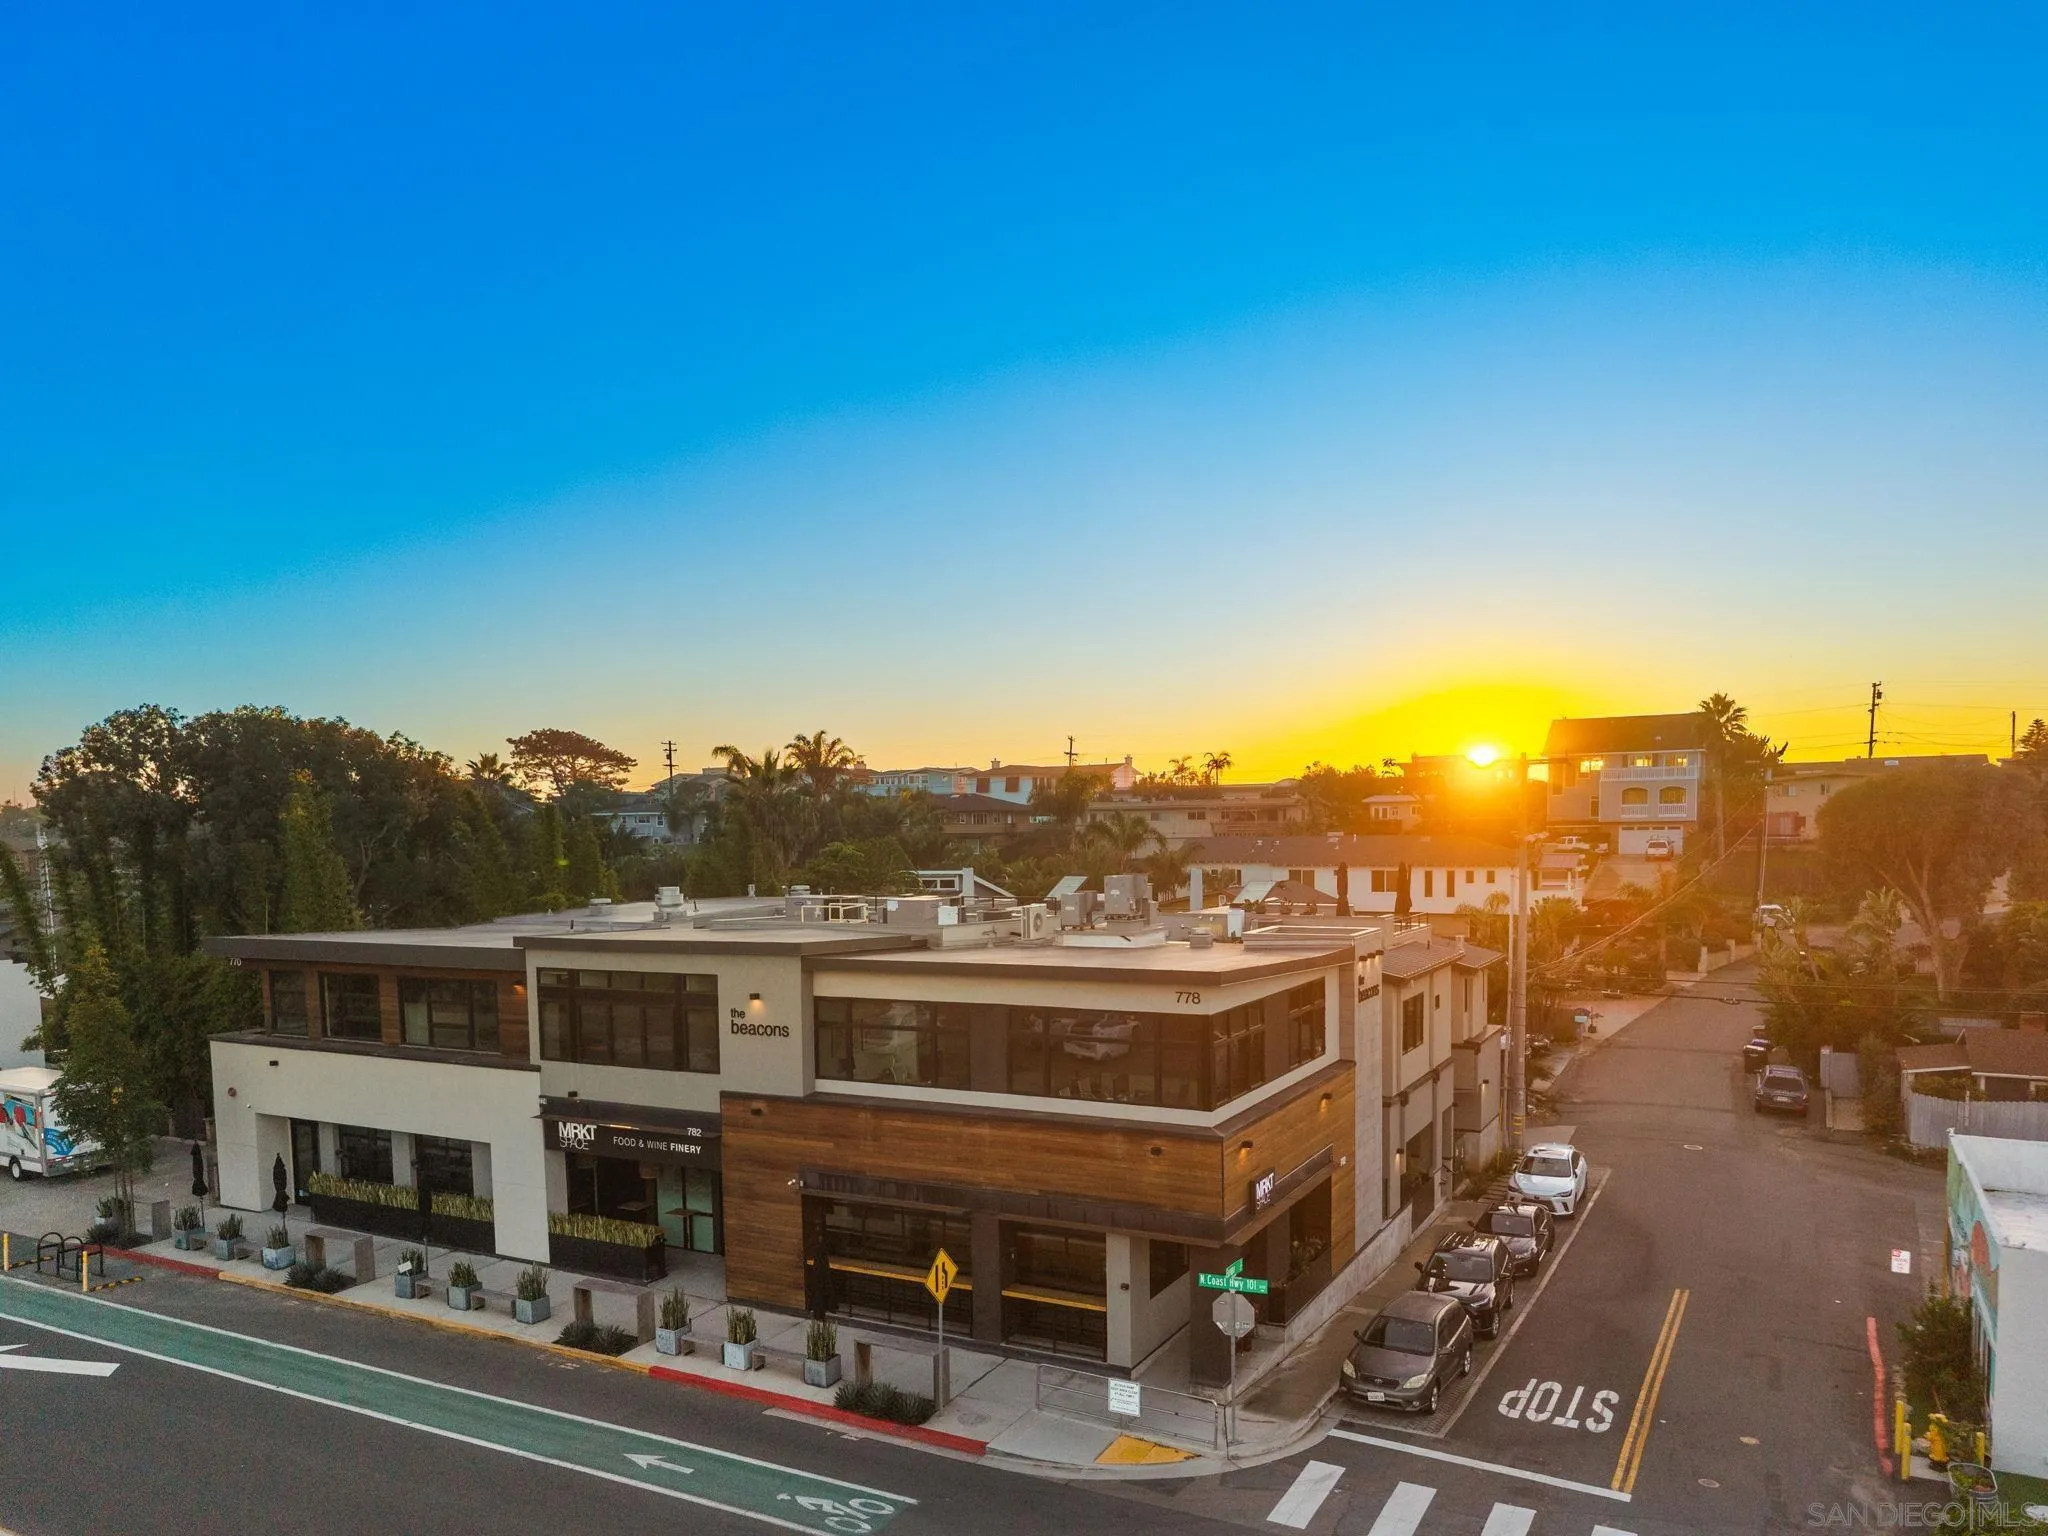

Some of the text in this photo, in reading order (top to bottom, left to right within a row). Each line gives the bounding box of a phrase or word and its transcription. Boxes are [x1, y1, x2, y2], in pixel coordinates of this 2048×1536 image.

[1175, 991, 1201, 1004] 778
[731, 1008, 746, 1019] the
[731, 1019, 790, 1037] beacons
[558, 1122, 597, 1140] MRKT
[687, 1127, 702, 1137] 782
[559, 1137, 590, 1150] SPACE
[613, 1136, 701, 1155] FOOD & WINE FINERY
[1207, 1275, 1227, 1287] Coast
[1229, 1278, 1244, 1290] Hwy
[1246, 1280, 1257, 1290] 101
[1498, 1378, 1620, 1433] STOP
